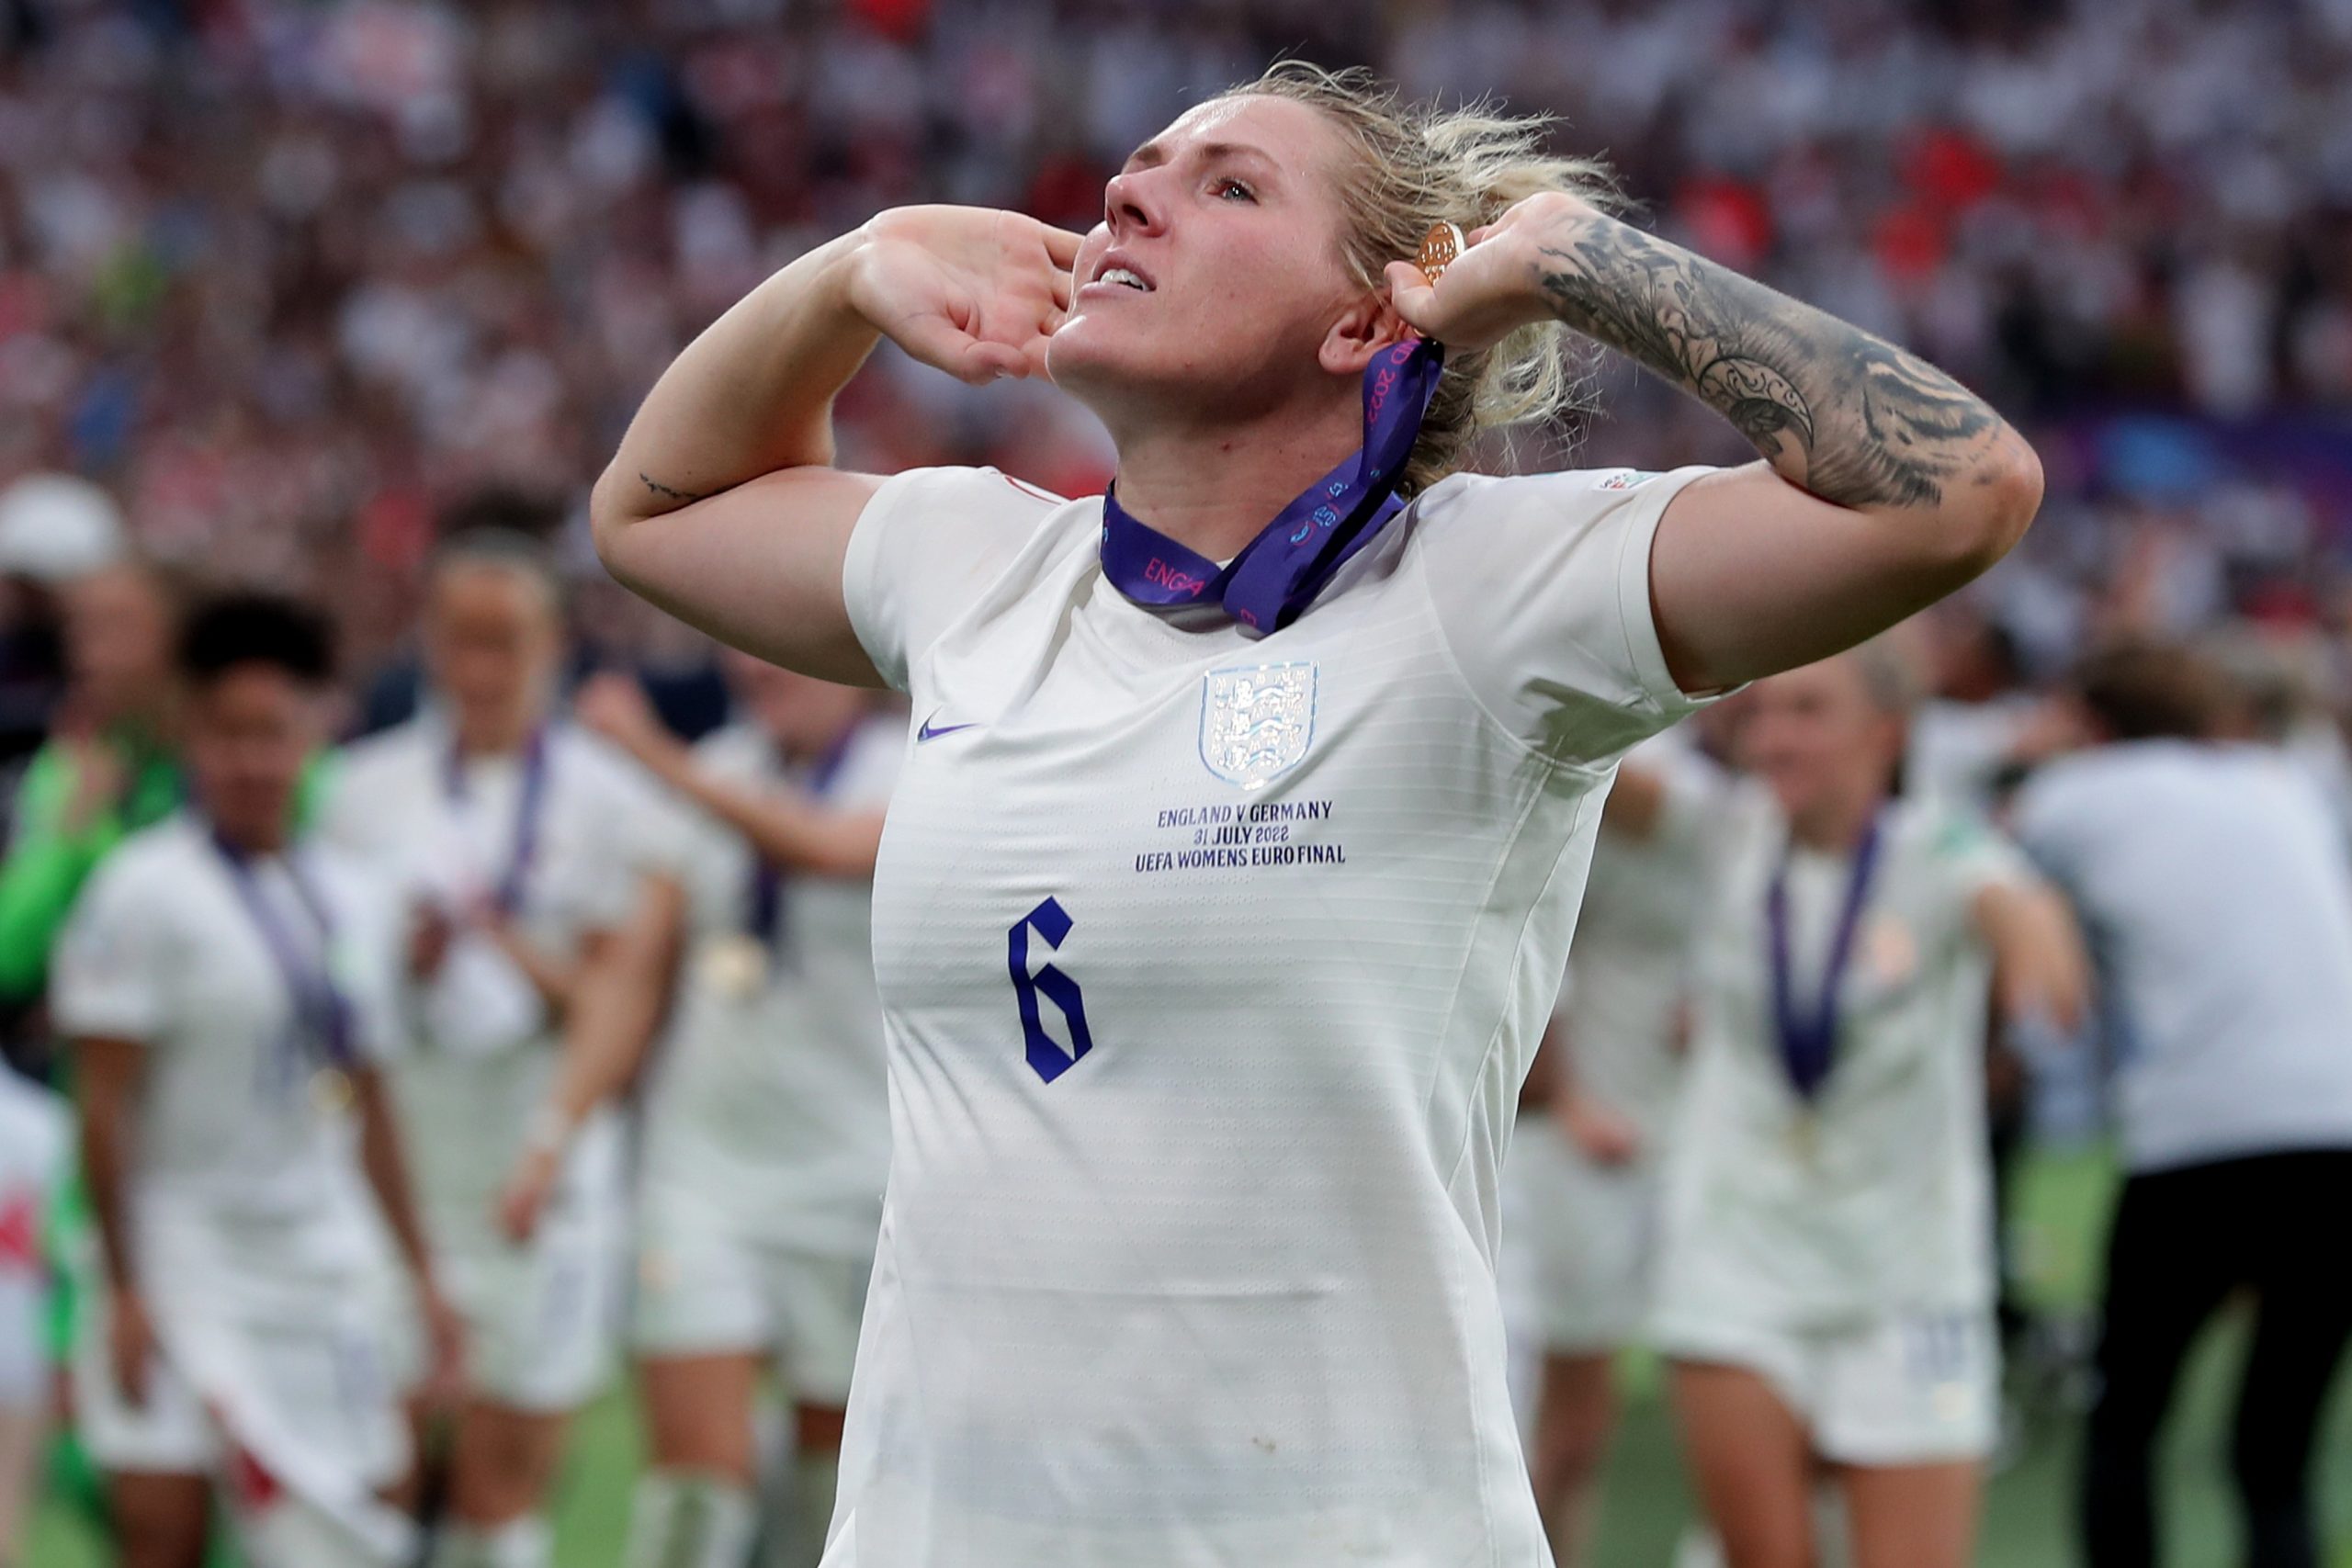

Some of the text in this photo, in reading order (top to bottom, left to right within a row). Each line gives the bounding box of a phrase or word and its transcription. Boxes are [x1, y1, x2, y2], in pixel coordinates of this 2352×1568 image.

[1158, 800, 1332, 828] ENGLAND V GERMANY
[1193, 825, 1289, 845] 31 JULY 2022
[1136, 844, 1346, 872] UEFA WOMENS EURO FINAL
[1008, 895, 1093, 1085] 6
